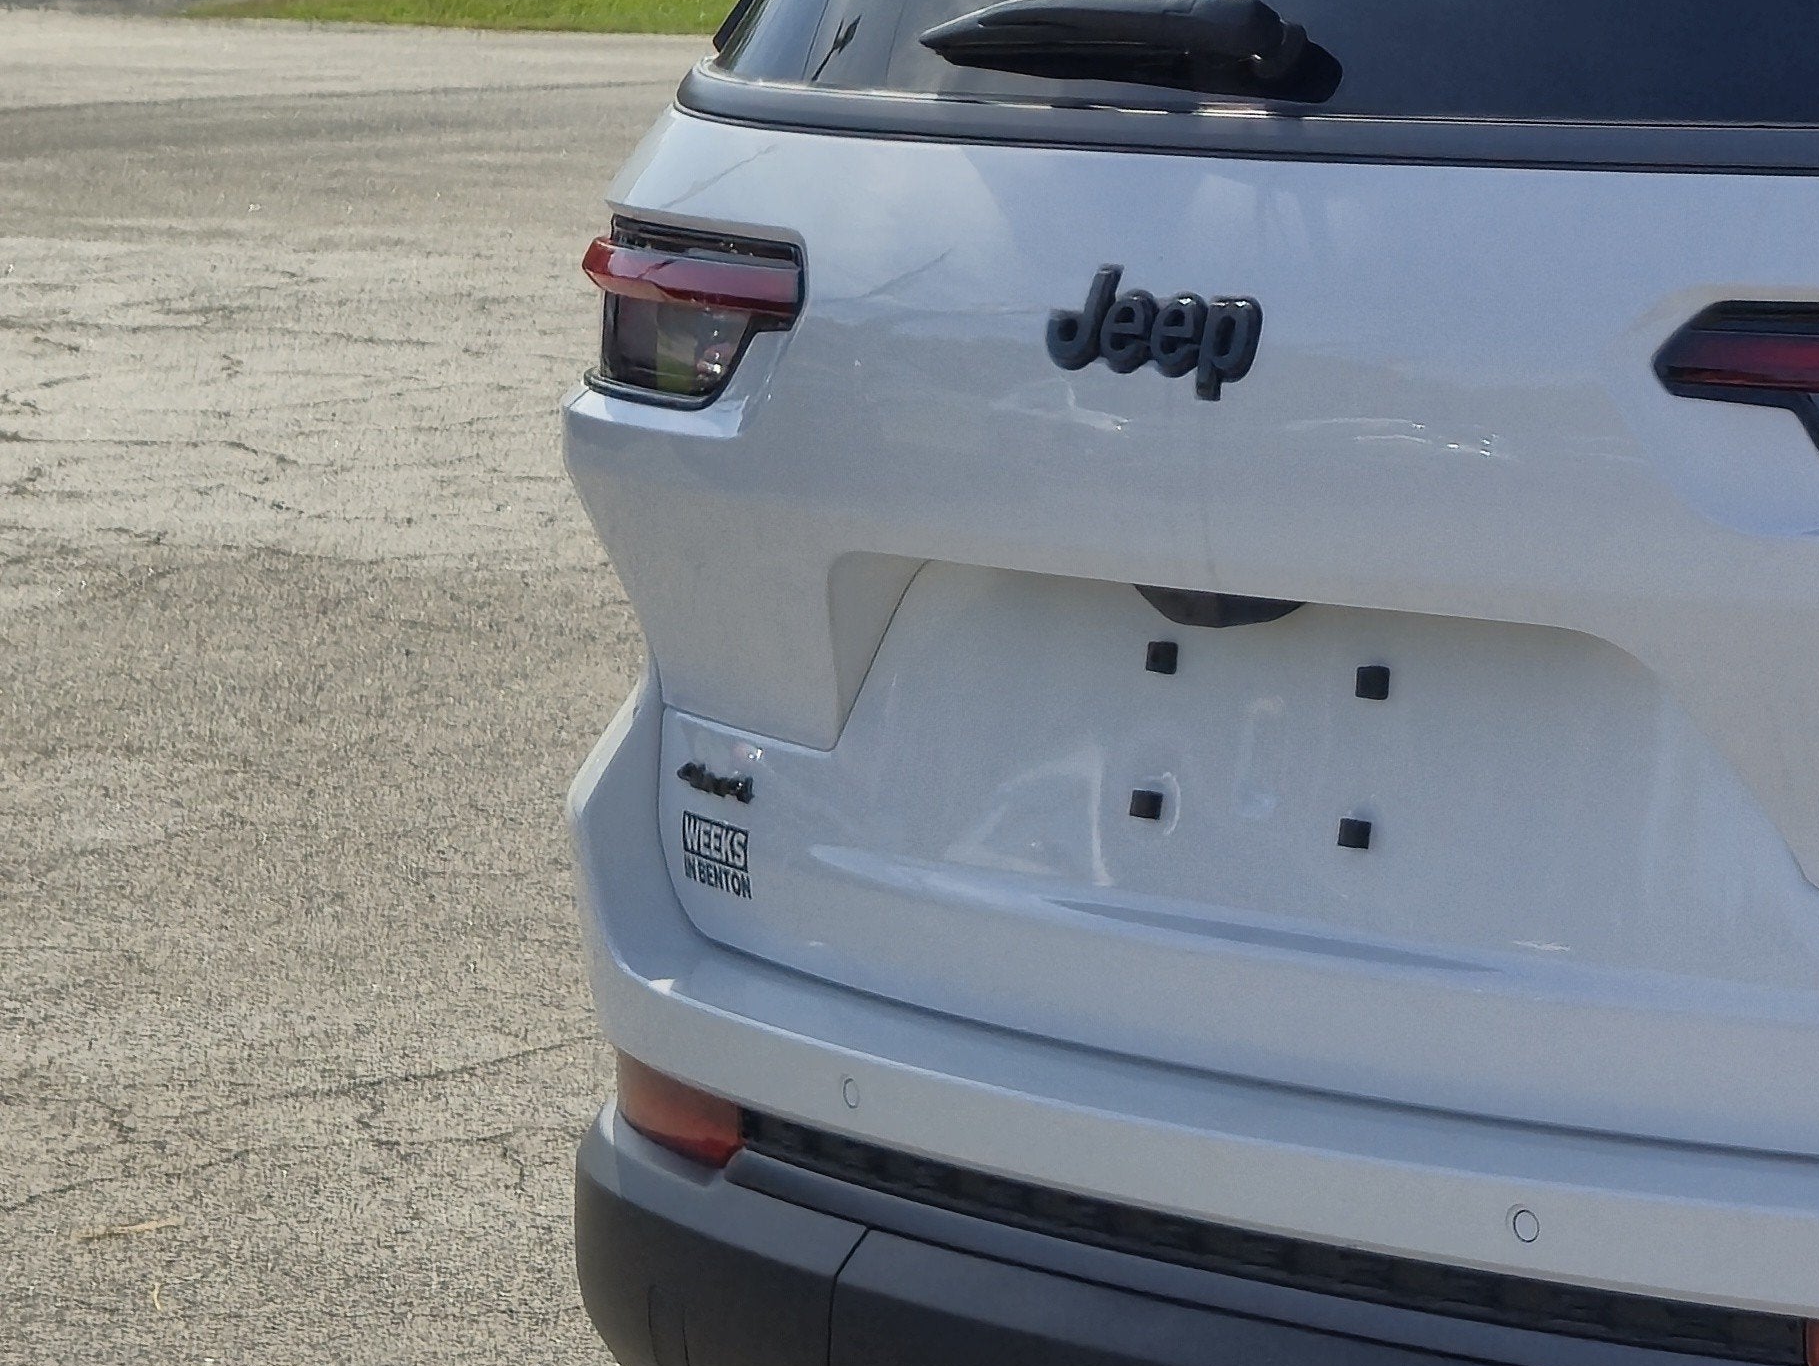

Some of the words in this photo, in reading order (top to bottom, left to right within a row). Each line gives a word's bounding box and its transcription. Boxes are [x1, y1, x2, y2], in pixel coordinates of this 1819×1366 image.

[1046, 263, 1263, 401] Jeep
[684, 813, 748, 869] WEEKS
[684, 853, 698, 882] IN
[699, 859, 753, 900] BENTON
